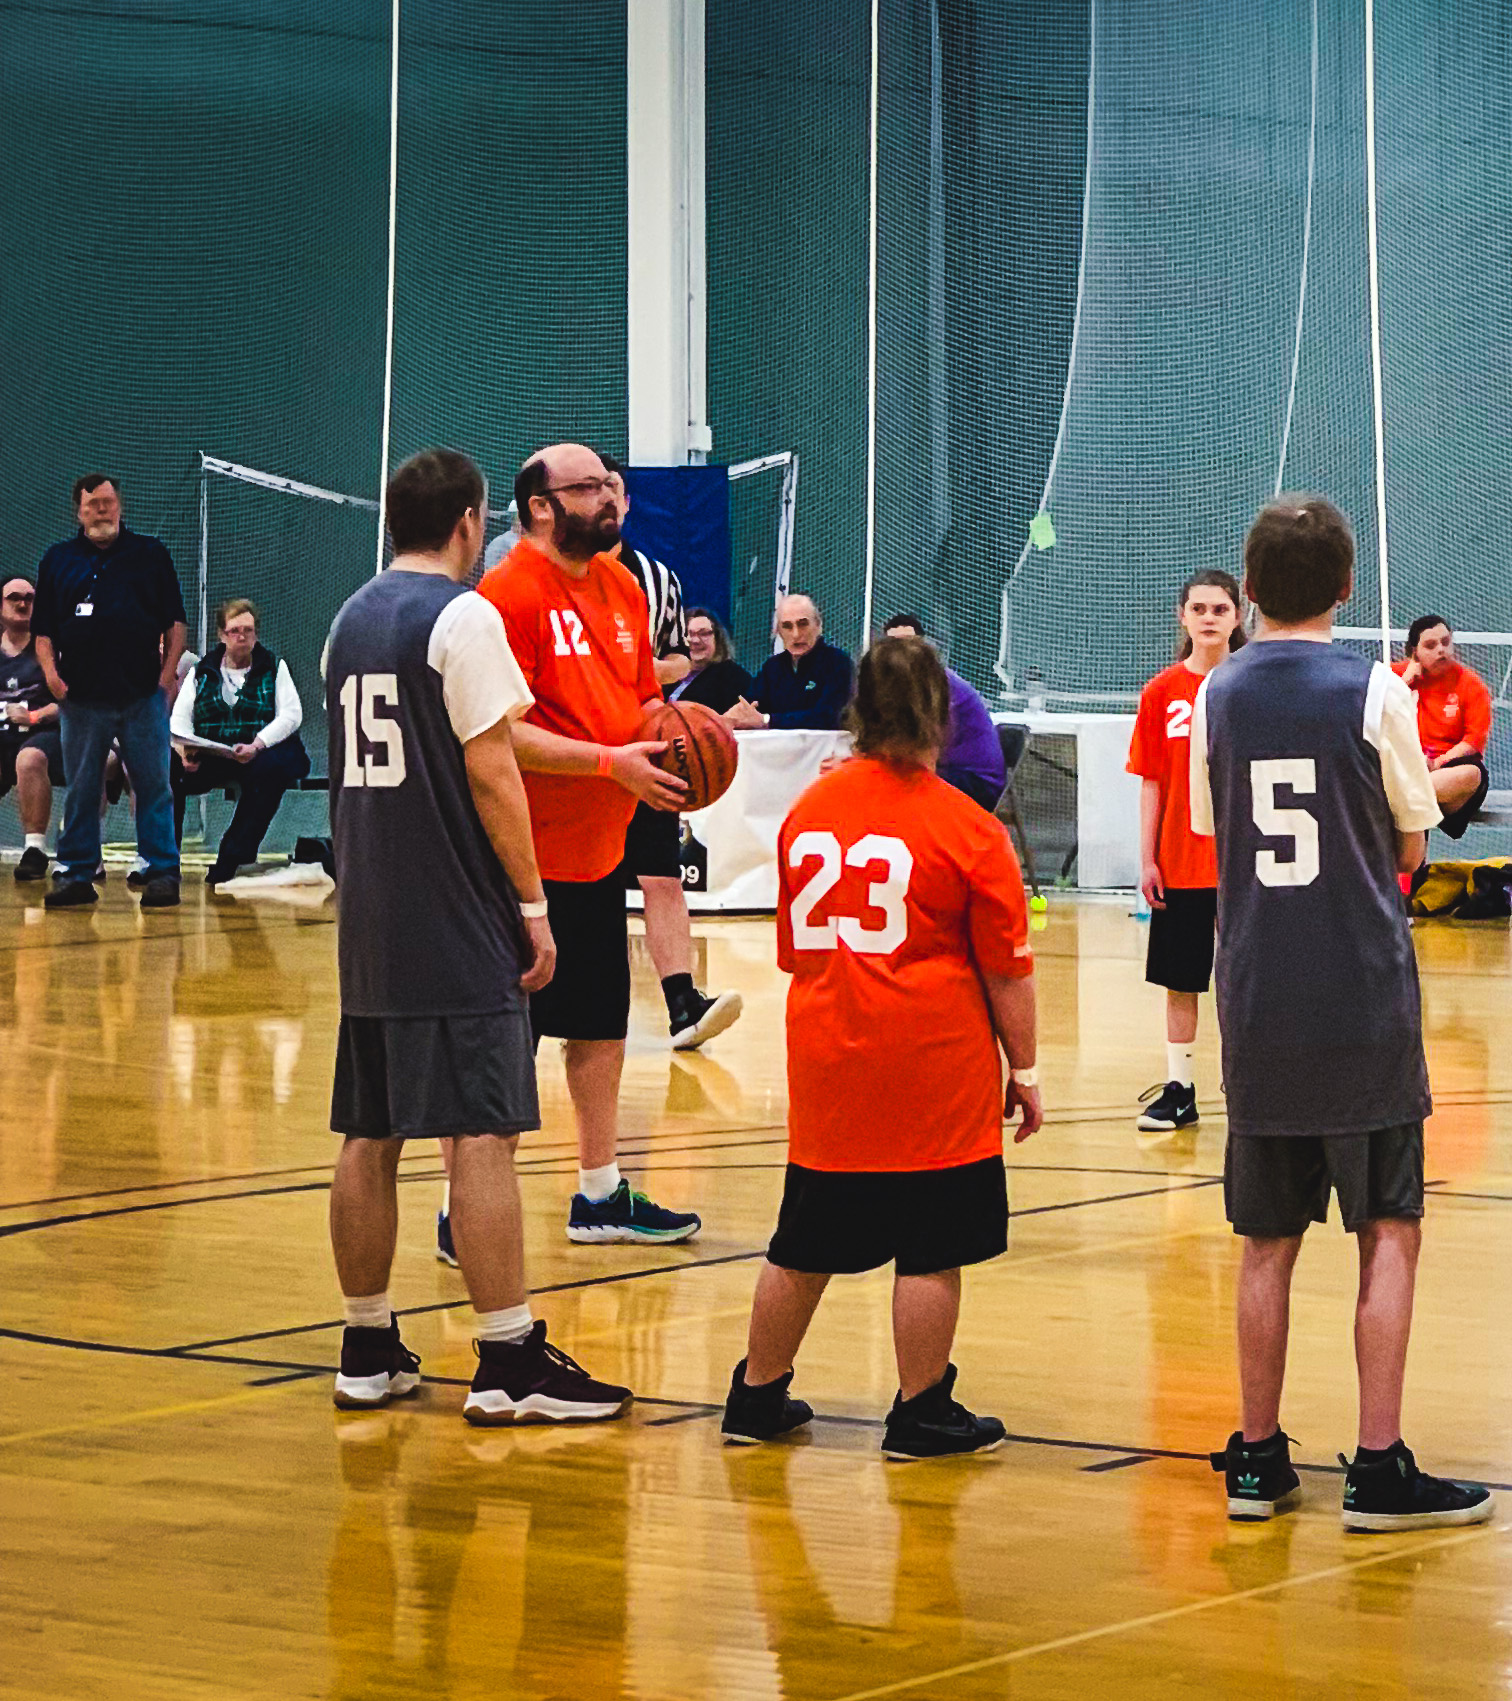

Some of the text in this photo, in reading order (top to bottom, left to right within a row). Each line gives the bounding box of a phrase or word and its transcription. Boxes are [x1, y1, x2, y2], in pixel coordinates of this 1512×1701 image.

[549, 609, 592, 656] 12
[340, 673, 407, 788] 15
[1249, 758, 1320, 888] 5
[788, 830, 914, 955] 23
